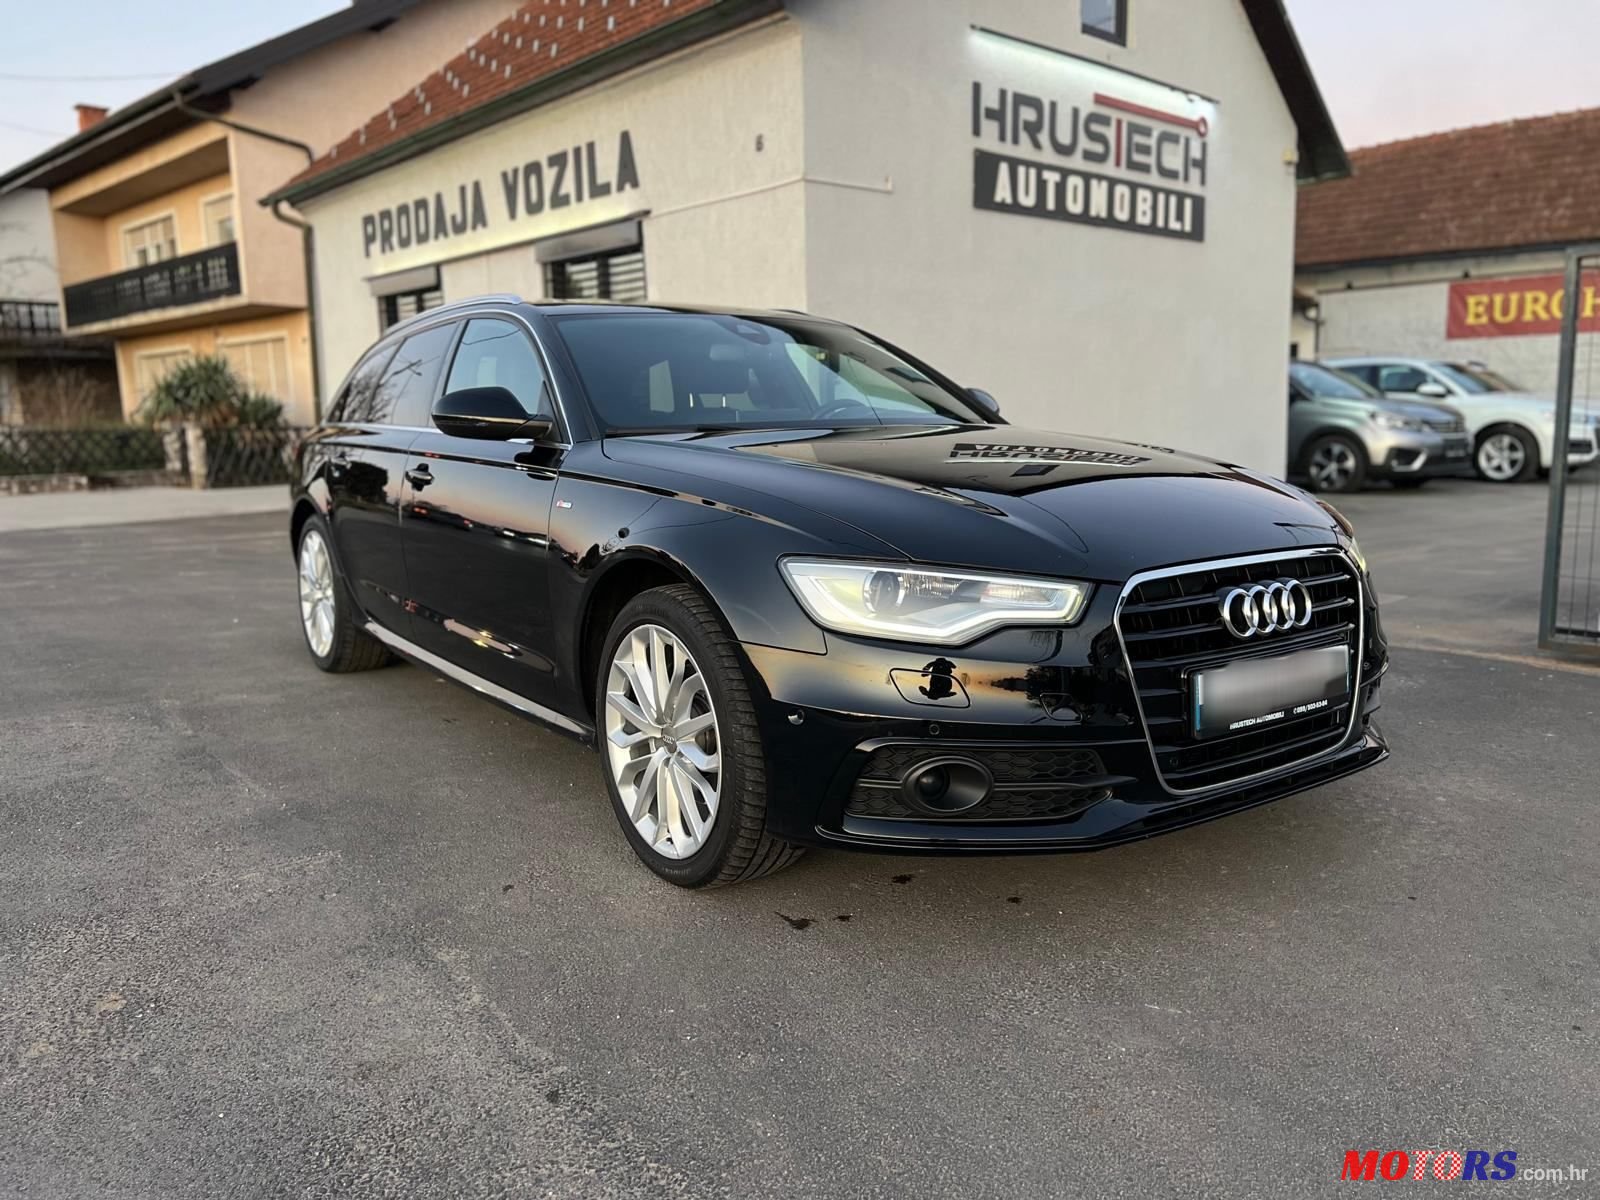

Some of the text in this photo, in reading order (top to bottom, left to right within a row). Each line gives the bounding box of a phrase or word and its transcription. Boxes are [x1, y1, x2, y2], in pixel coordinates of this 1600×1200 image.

[972, 81, 1208, 187] HRUSTECH
[362, 130, 640, 258] PRODAJA VOZILA
[994, 161, 1193, 233] AUTOMOBILI
